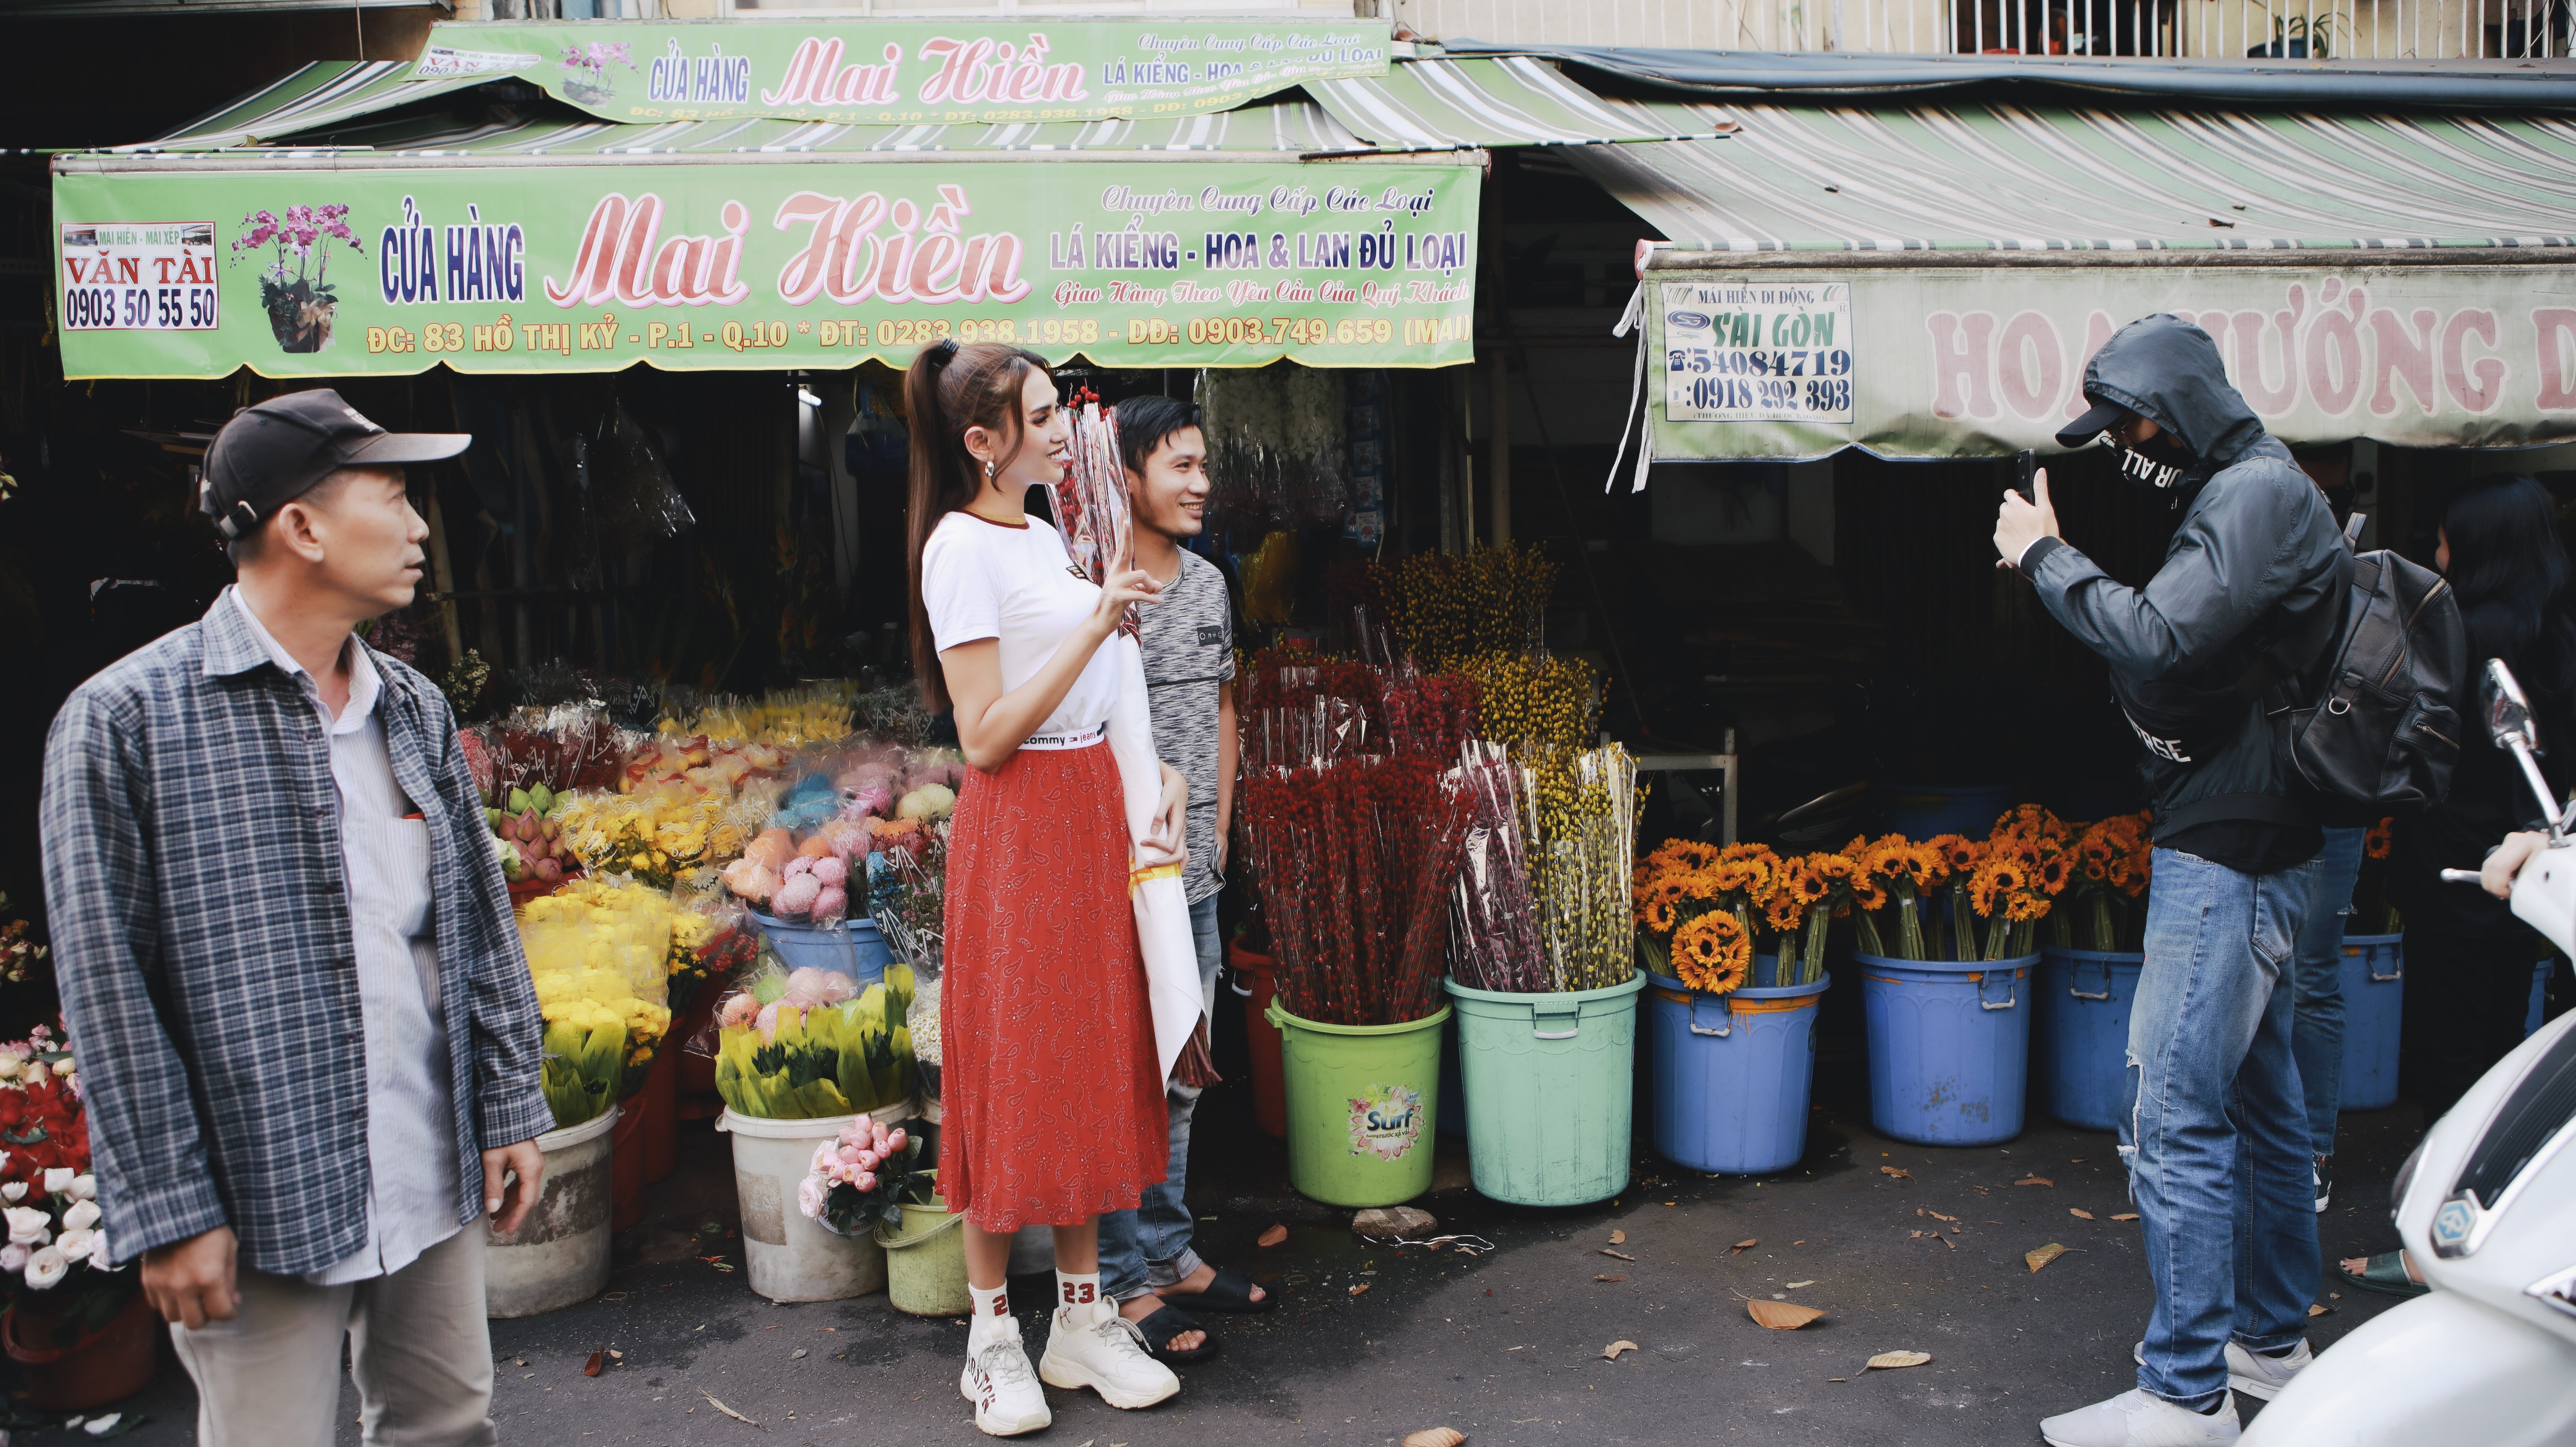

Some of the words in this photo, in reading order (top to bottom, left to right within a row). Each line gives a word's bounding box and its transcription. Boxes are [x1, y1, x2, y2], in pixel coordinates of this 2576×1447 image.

[1138, 34, 1199, 53] Chuyên
[1204, 34, 1247, 51] Cung
[1250, 33, 1282, 52] Cấp
[1288, 33, 1317, 49] Các
[650, 38, 688, 101] CỬA
[695, 44, 749, 102] HÀNG
[762, 37, 902, 105] Mai
[919, 33, 1089, 104] Hiền
[1104, 57, 1126, 84] LÁ
[1134, 52, 1189, 84] KIỂNG
[670, 109, 700, 118] 83
[983, 107, 1134, 120] 0283.938.1958
[1103, 185, 1194, 215] Chuyên
[1200, 185, 1263, 215] Cung
[1270, 186, 1320, 216] Cấp
[1326, 186, 1370, 211] Các
[1375, 187, 1434, 217] Loại
[99, 227, 114, 245] MÁI
[117, 228, 137, 245] HIÊN
[146, 227, 161, 245] MÁI
[164, 225, 179, 245] XẾP
[382, 196, 438, 302] CỬA
[447, 205, 523, 302] HÀNG
[545, 193, 750, 308] Mai
[774, 185, 1031, 305] Hiền
[1051, 223, 1085, 269] LÁ
[1096, 215, 1179, 269] KIỂNG
[1206, 234, 1260, 269] HOA
[1268, 234, 1289, 268] &
[1298, 233, 1349, 267] LAN
[1359, 220, 1395, 269] ĐỦ
[1406, 233, 1466, 276] LOẠI
[65, 249, 141, 284] VĂN
[153, 248, 215, 284] TÀI
[67, 288, 116, 327] 0903
[124, 288, 151, 327] 50
[158, 288, 183, 327] 55
[190, 288, 215, 327] 50
[1053, 281, 1102, 308] Giao
[1109, 281, 1166, 307] Hàng
[1172, 281, 1221, 302] Theo
[1228, 281, 1271, 306] Yêu
[1276, 279, 1314, 302] Cầu
[1319, 280, 1357, 303] Của
[1362, 281, 1401, 308] Quý
[1405, 279, 1469, 303] Khách
[1698, 287, 1722, 304] MÁI
[1726, 287, 1757, 304] HIÊN
[1761, 290, 1774, 304] DI
[1779, 287, 1815, 308] ĐỘNG
[367, 326, 416, 353] ĐC:
[423, 322, 465, 352] 83
[473, 313, 517, 352] HỒ
[522, 323, 571, 356] THỊ
[579, 313, 619, 350] KỶ
[629, 334, 641, 343] -
[649, 322, 694, 348] P.1
[703, 333, 715, 342] -
[722, 320, 789, 352] Q.10
[819, 320, 868, 346] ĐT:
[876, 318, 1099, 345] 0283.938.1958
[1107, 330, 1119, 338] -
[1128, 318, 1179, 345] DĐ:
[1188, 317, 1393, 345] 0903.749.659
[1403, 313, 1472, 347] (MAI)
[1712, 306, 1762, 347] SÀI
[1772, 306, 1835, 346] GÒN
[2169, 276, 2507, 416] ƯỚNG
[1757, 379, 1798, 410] 292
[1806, 379, 1850, 411] 393
[2121, 449, 2157, 480] ALL
[1080, 732, 1096, 743] jeans
[1367, 1107, 1415, 1131] Surf
[1062, 1281, 1095, 1304] 23
